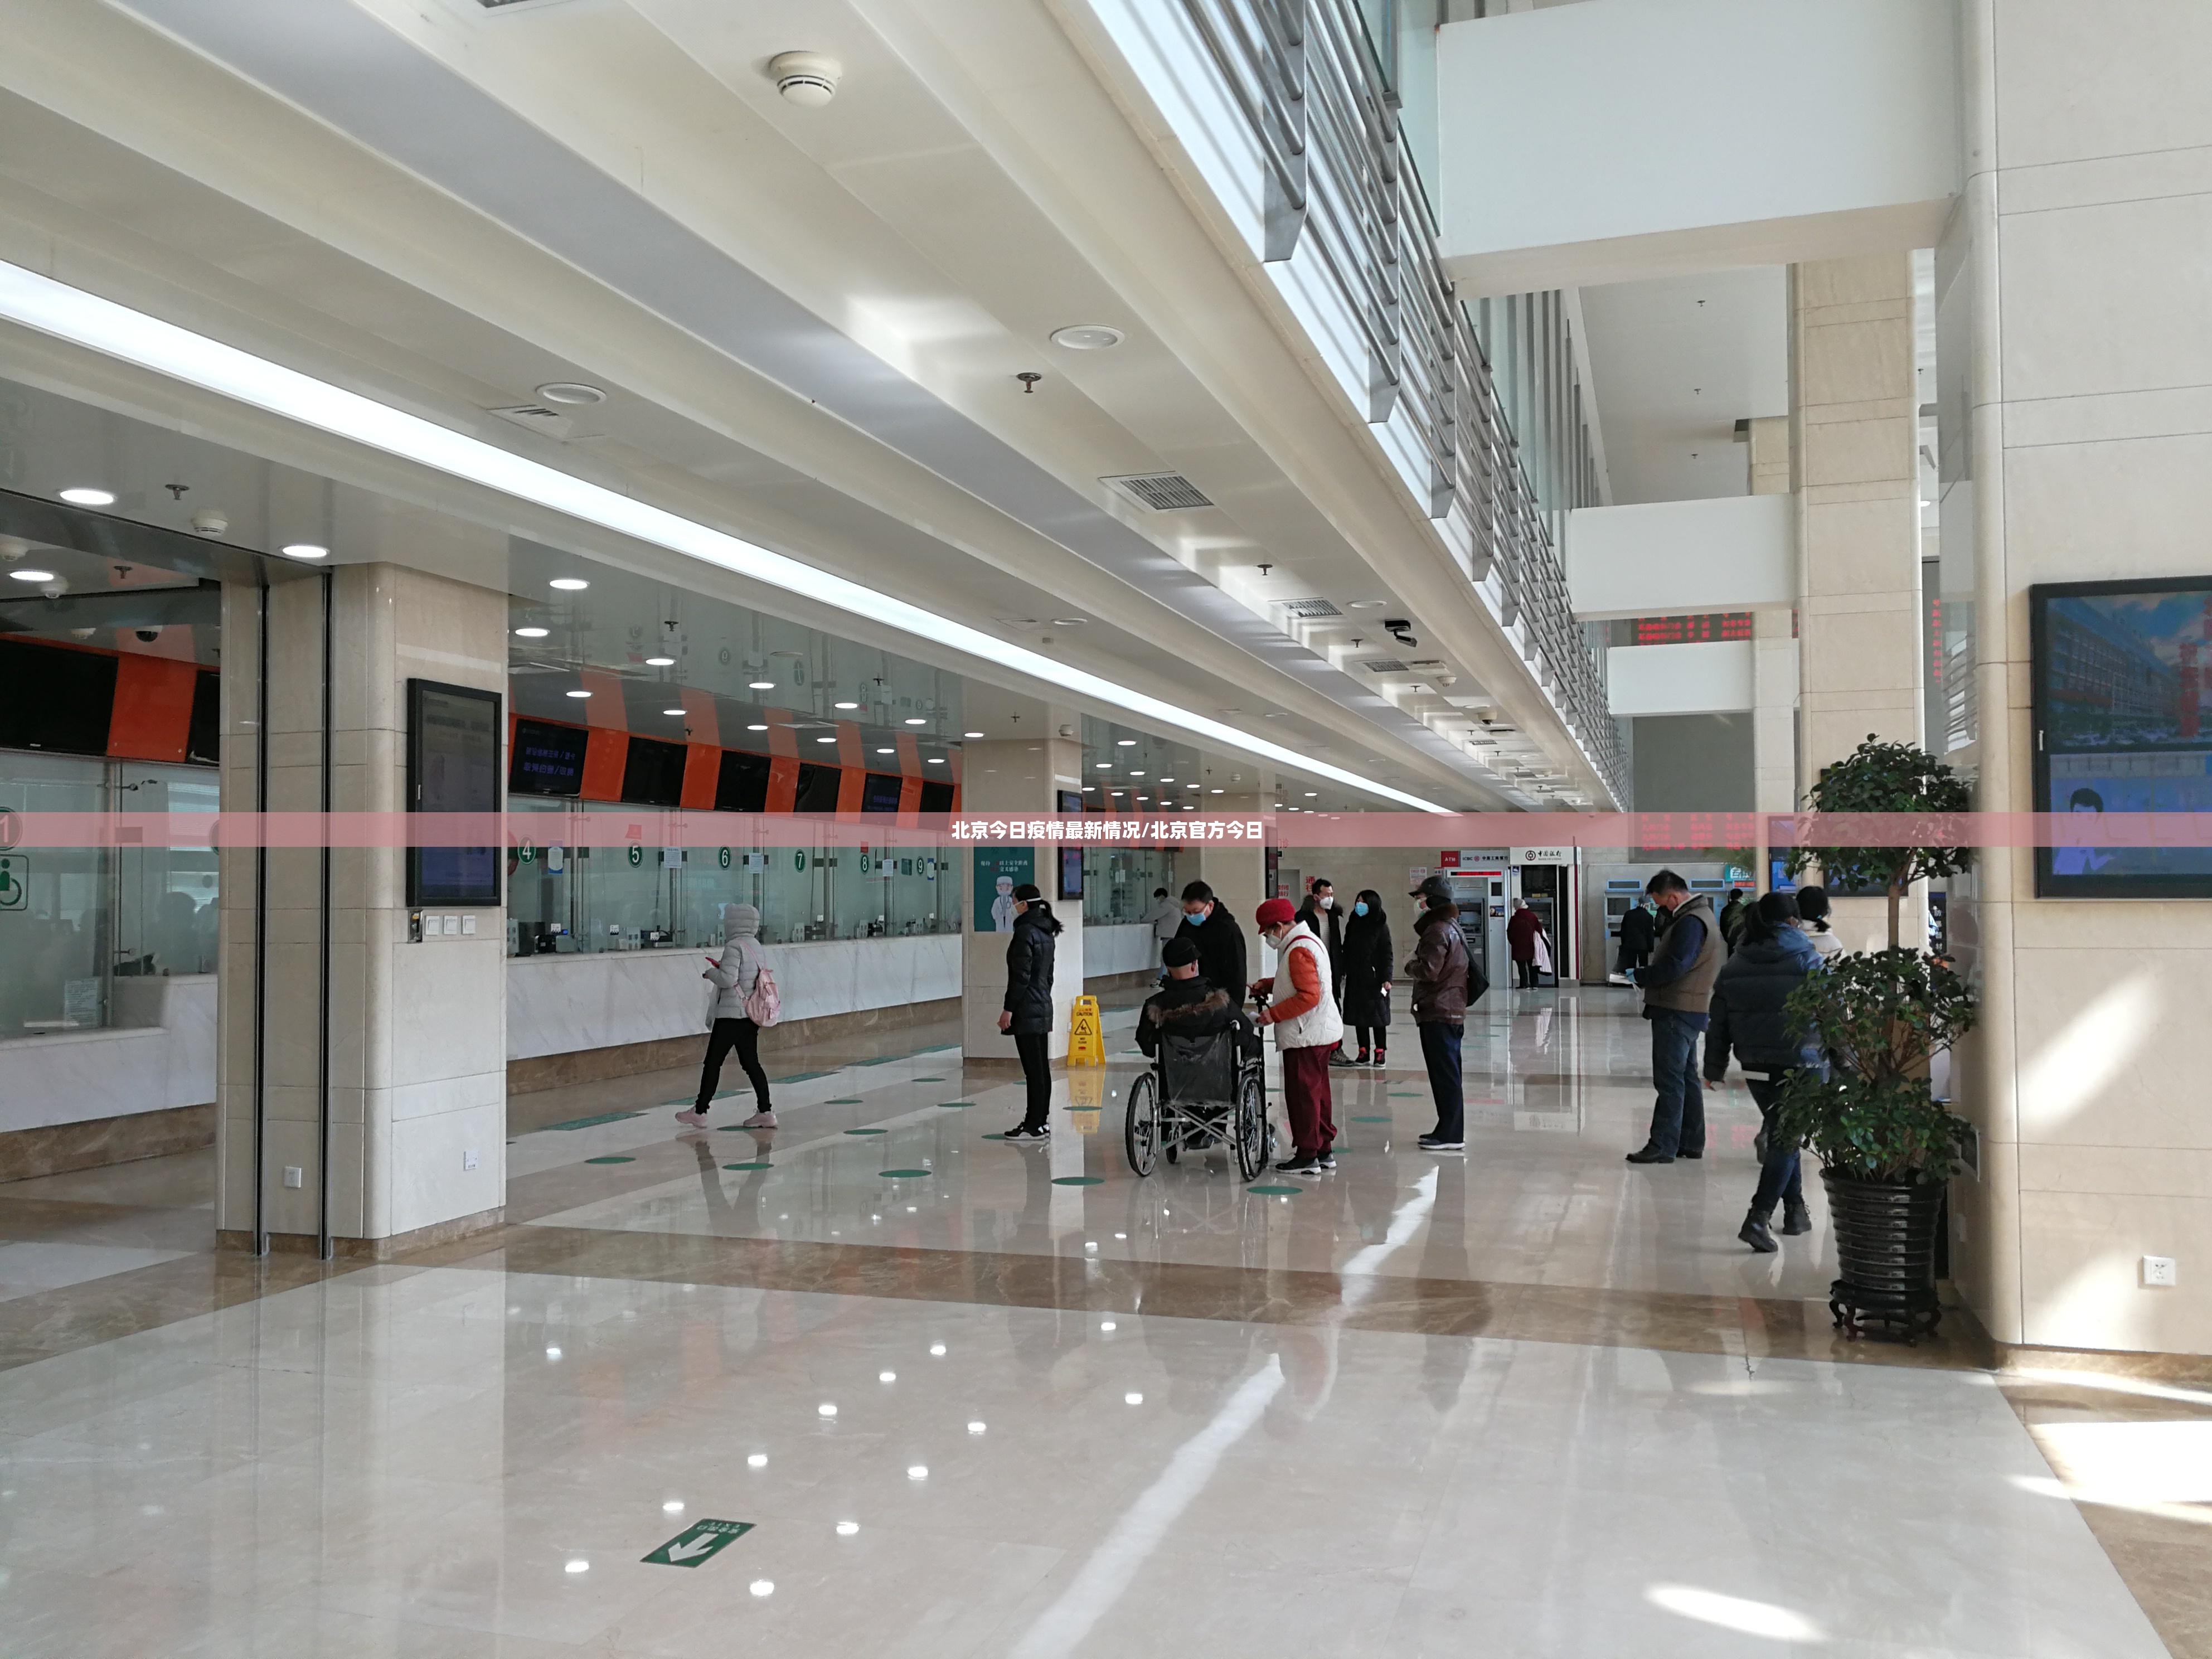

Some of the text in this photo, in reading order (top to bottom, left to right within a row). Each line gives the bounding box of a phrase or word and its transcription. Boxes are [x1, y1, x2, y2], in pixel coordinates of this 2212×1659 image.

[522, 840, 531, 860] 4
[632, 845, 639, 863] 5
[721, 850, 728, 866] 6
[797, 853, 803, 869] 7
[862, 856, 867, 871] 8
[918, 859, 923, 872] 9
